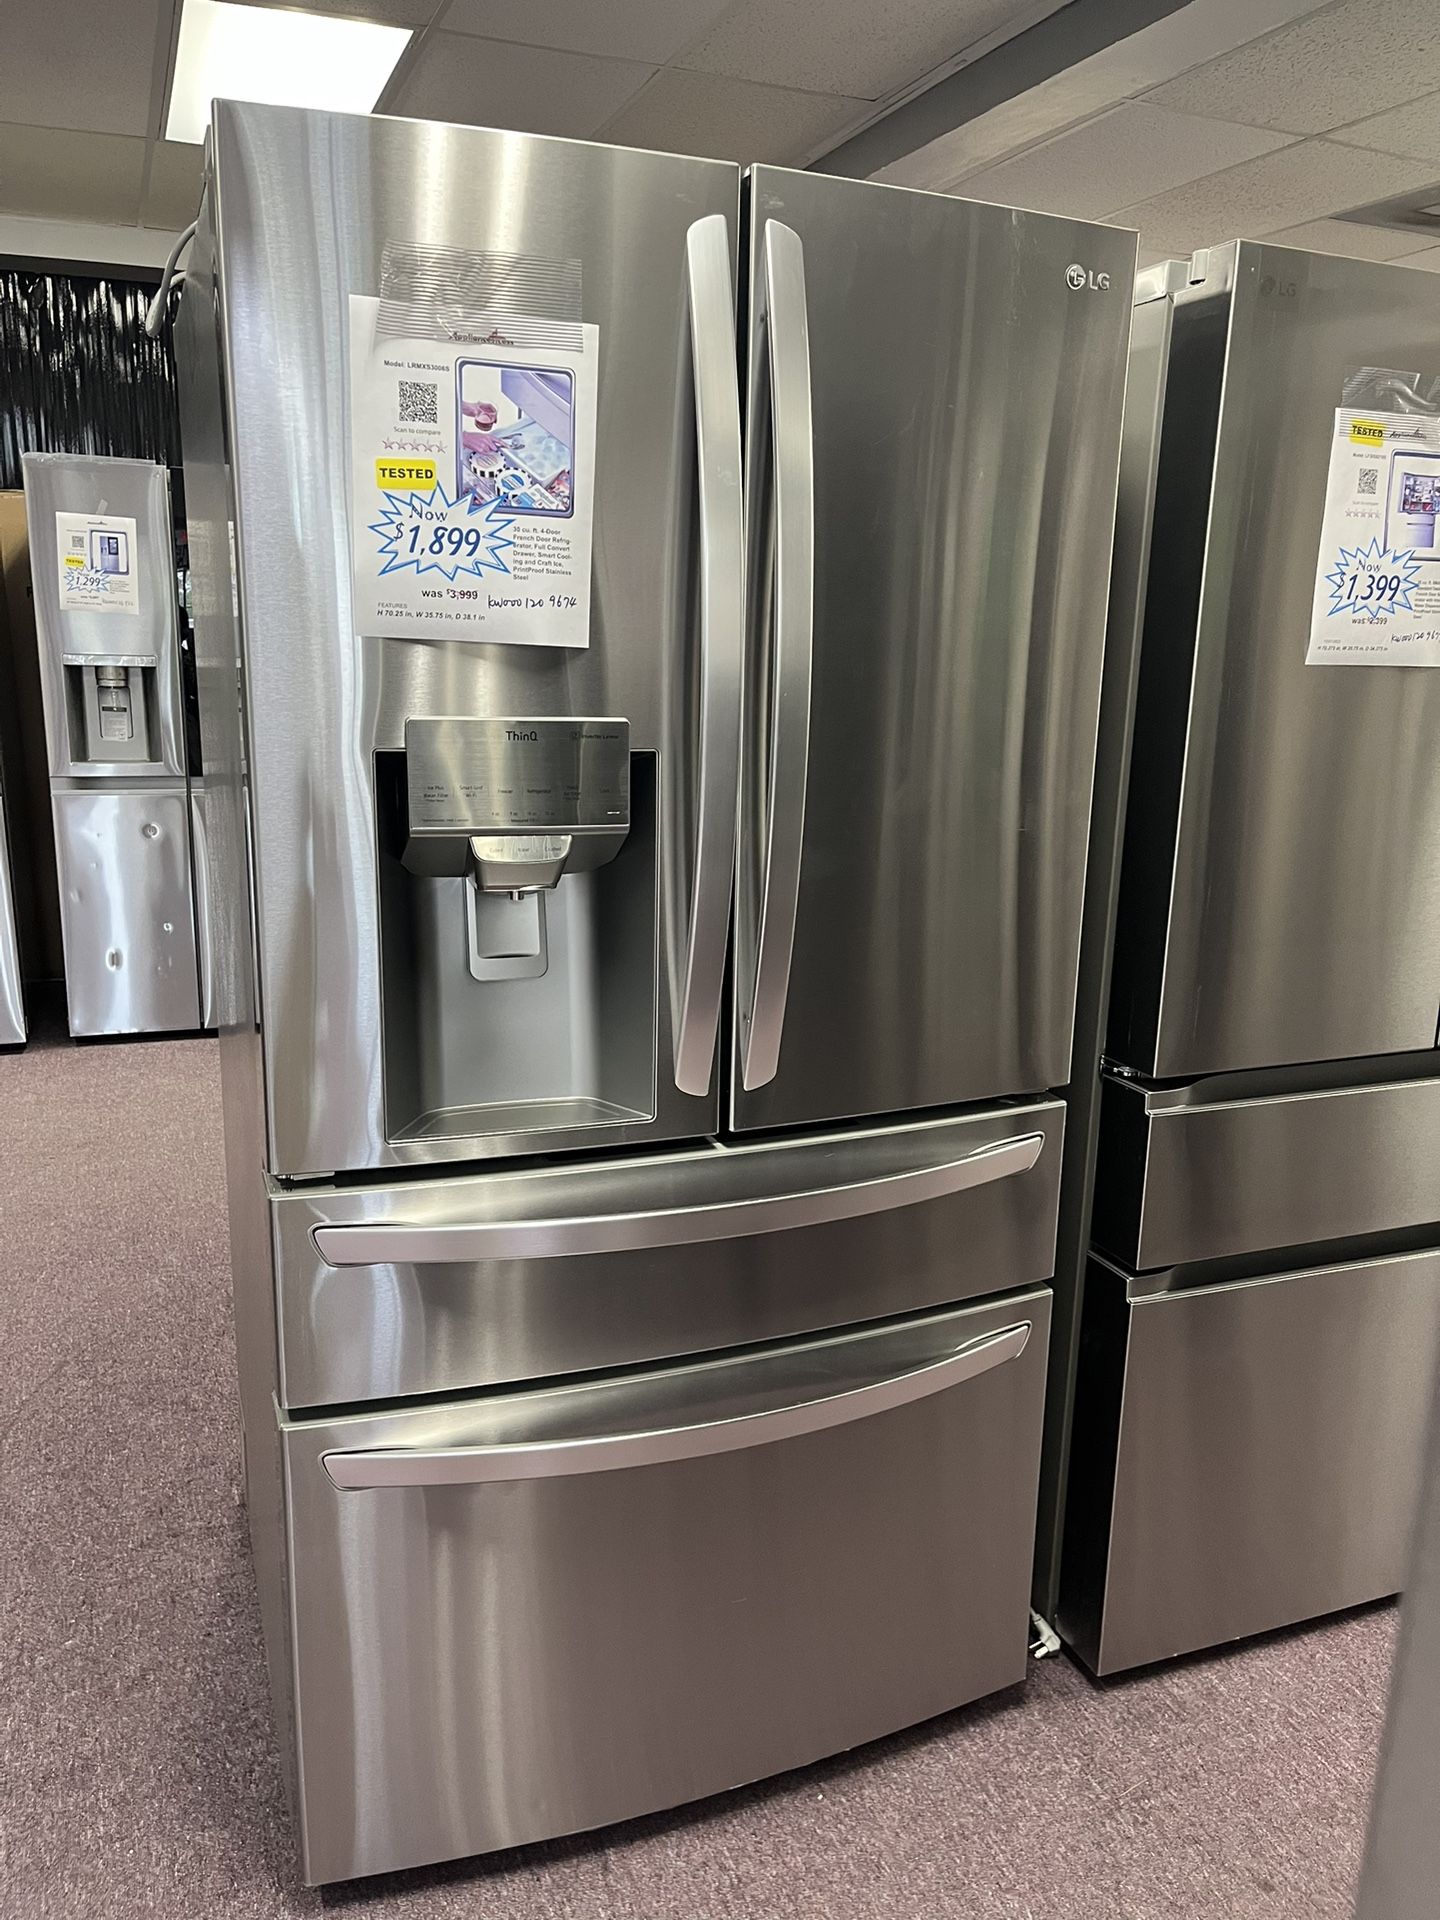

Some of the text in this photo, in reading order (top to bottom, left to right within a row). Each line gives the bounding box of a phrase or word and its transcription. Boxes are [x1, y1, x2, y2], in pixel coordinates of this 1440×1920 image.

[1089, 270, 1110, 291] LG
[1278, 281, 1297, 297] LG
[393, 426, 408, 434] Scan
[416, 428, 441, 436] compare
[1352, 425, 1383, 438] TESTED
[379, 467, 433, 479] TESTED
[409, 502, 448, 522] Now
[393, 521, 481, 557] $1,899
[535, 535, 552, 543] Door
[537, 551, 556, 559] Smart
[1356, 559, 1382, 573] Now
[513, 573, 529, 581] Steel
[421, 588, 478, 600] was $3,999
[505, 730, 538, 741] ThinQ
